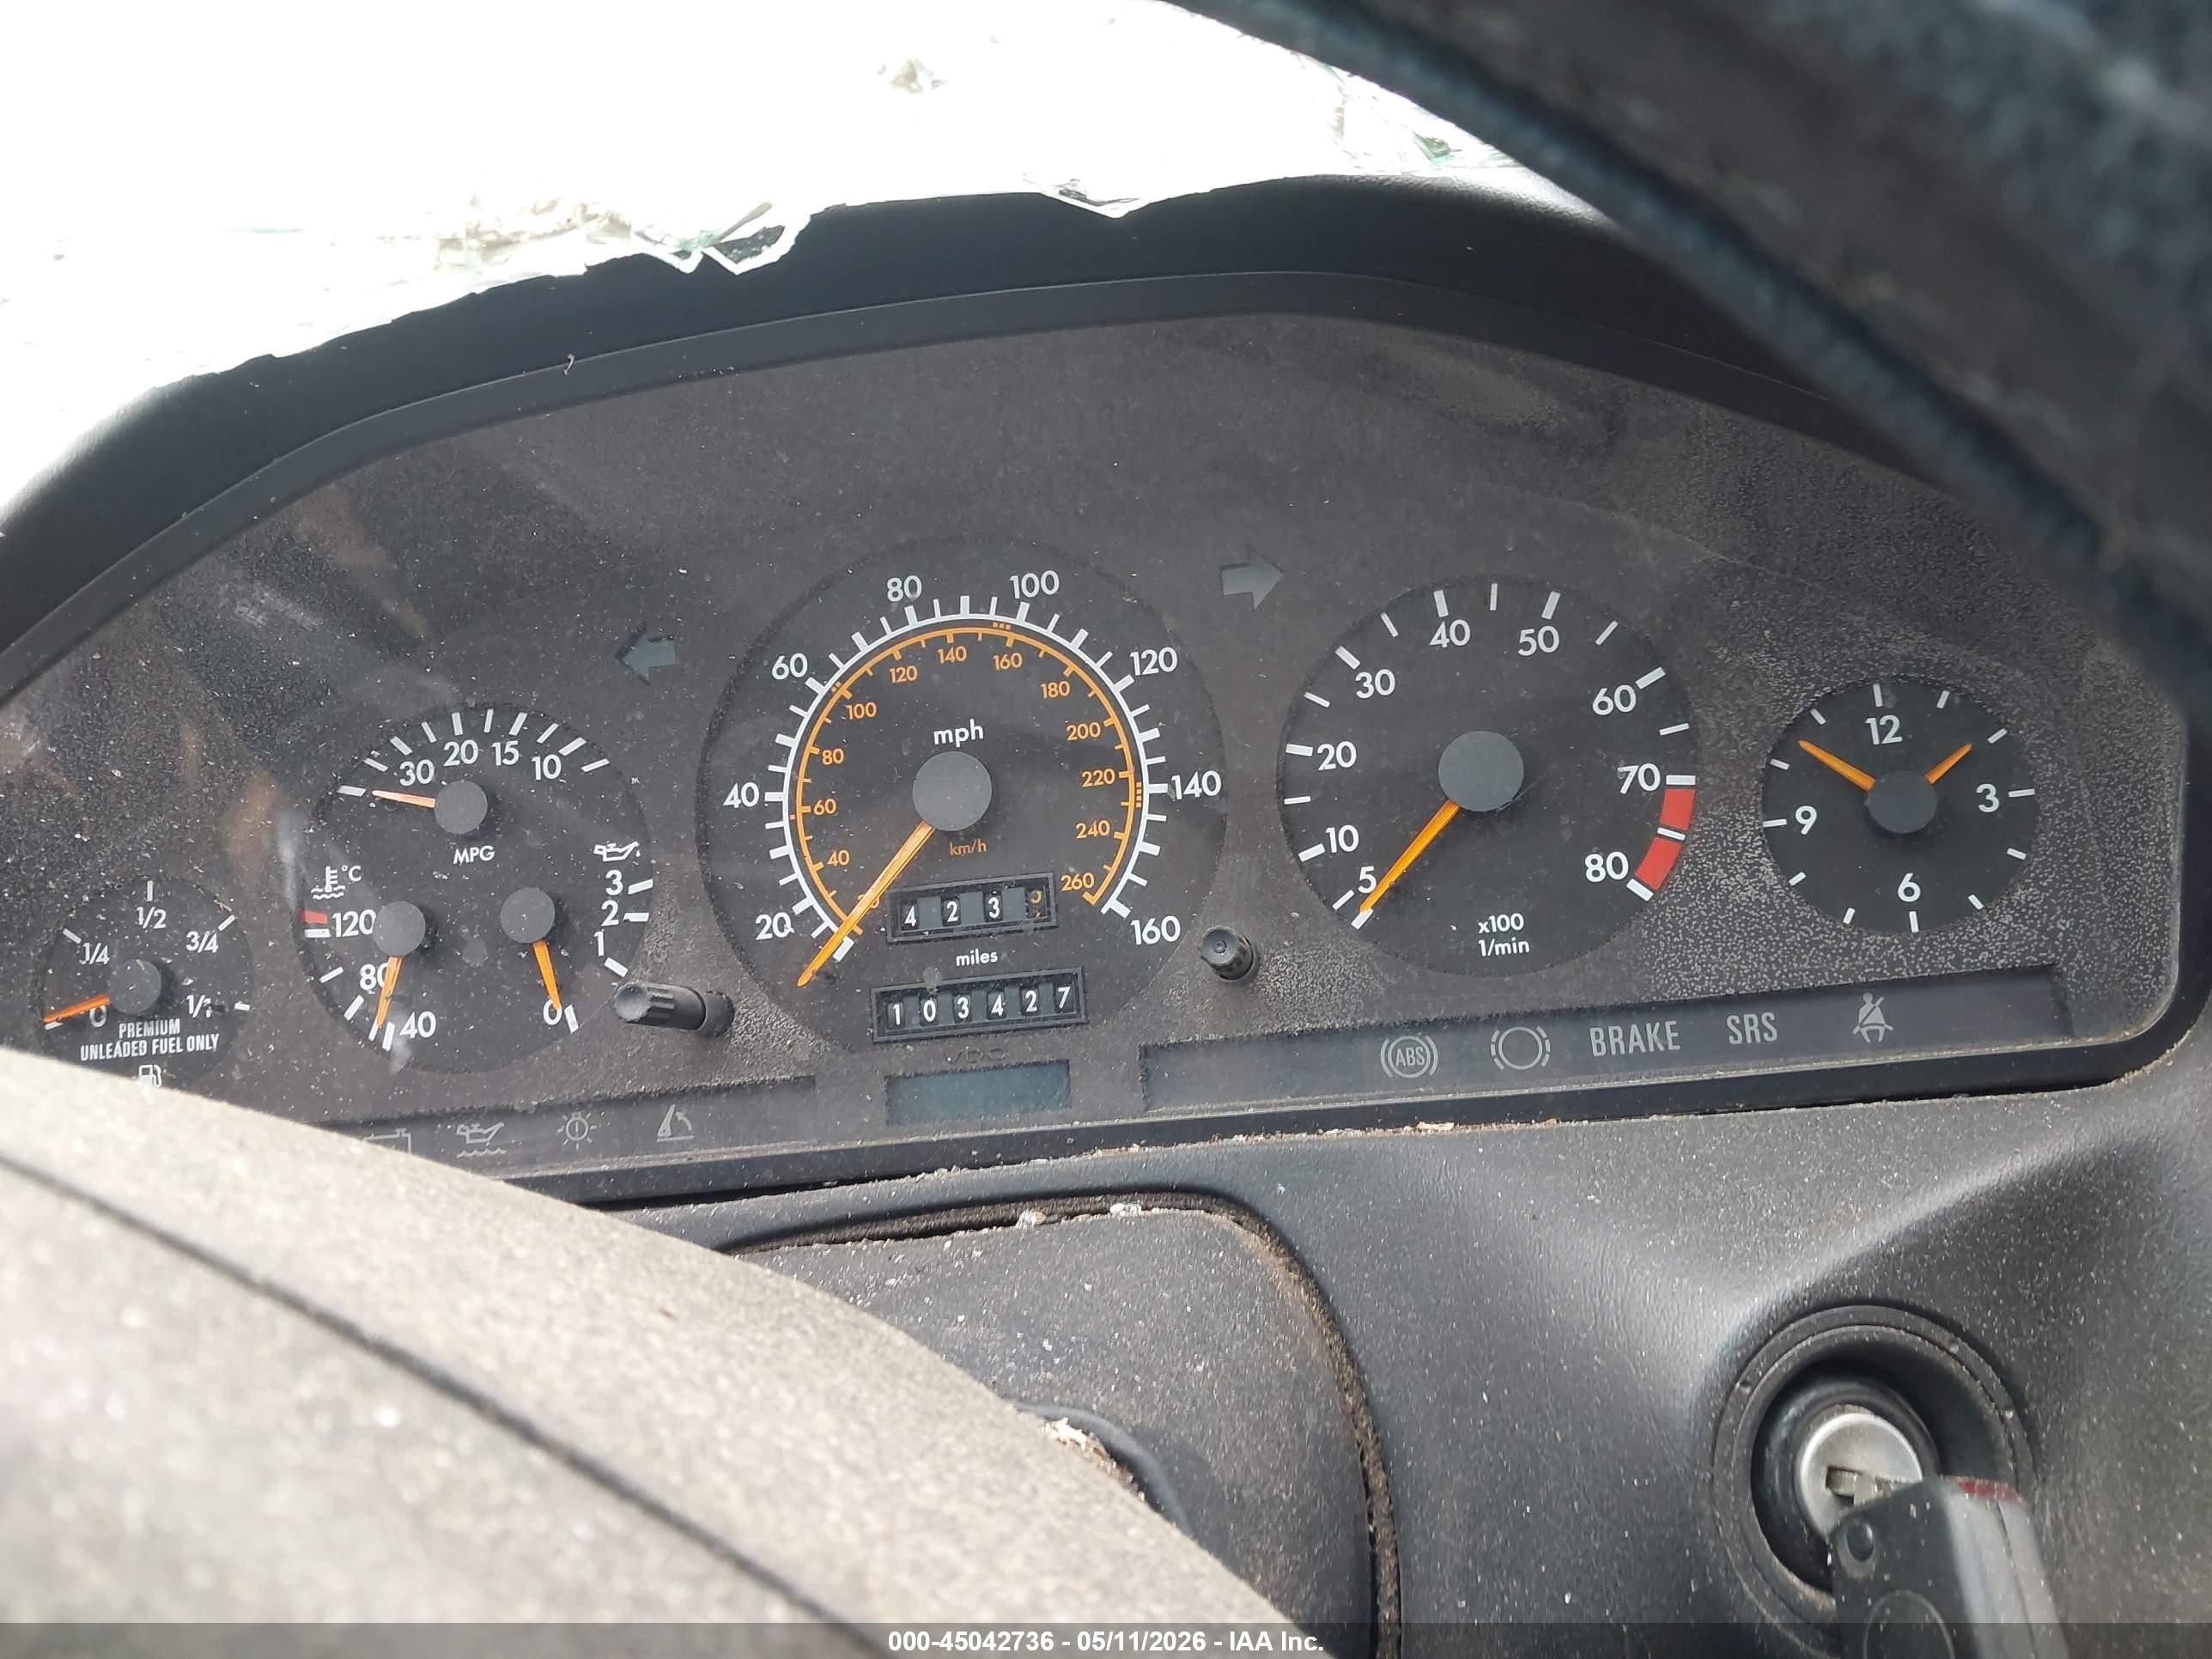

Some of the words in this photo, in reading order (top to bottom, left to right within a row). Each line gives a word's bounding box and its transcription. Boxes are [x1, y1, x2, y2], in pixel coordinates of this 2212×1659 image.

[886, 575, 922, 603] 80
[1010, 570, 1060, 599] 100
[1429, 619, 1471, 648] 40
[1517, 626, 1559, 656] 50
[772, 653, 808, 680] 60
[937, 646, 967, 664] 140
[993, 652, 1023, 671] 160
[1129, 647, 1178, 676] 120
[889, 665, 918, 683] 120
[1354, 669, 1395, 698] 30
[1040, 680, 1070, 699] 180
[1592, 684, 1637, 715] 60
[846, 702, 877, 719] 100
[933, 719, 984, 748] mph
[1066, 722, 1102, 741] 200
[1865, 714, 1903, 745] 12
[443, 739, 478, 767] 20
[492, 740, 520, 766] 15
[822, 747, 844, 765] 80
[1316, 741, 1357, 771] 20
[399, 759, 434, 787] 30
[532, 754, 562, 781] 10
[1081, 769, 1115, 787] 220
[1617, 763, 1661, 794] 70
[723, 781, 760, 809] 40
[1171, 770, 1221, 800] 140
[1976, 783, 2000, 812] 3
[813, 798, 836, 816] 60
[1795, 805, 1818, 835] 9
[1075, 820, 1110, 839] 240
[1324, 824, 1359, 854] 10
[453, 846, 495, 865] MPG
[827, 849, 850, 866] 40
[949, 838, 987, 856] km/h
[341, 866, 362, 882] °C
[1358, 866, 1377, 894] 5
[1584, 851, 1629, 883] 80
[605, 870, 623, 896] 3
[1060, 872, 1095, 891] 260
[1897, 872, 1921, 902] 6
[137, 906, 167, 929] 1/2
[331, 909, 376, 938] 120
[601, 901, 619, 927] 2
[755, 911, 791, 940] 20
[1477, 913, 1525, 934] x100
[186, 932, 219, 953] 3/4
[1130, 915, 1181, 945] 160
[79, 942, 110, 965] 1/4
[593, 931, 605, 957] 1
[1478, 939, 1530, 957] 1/min
[956, 950, 998, 967] miles
[88, 1004, 107, 1027] 0
[544, 999, 562, 1025] 0
[893, 986, 1071, 1026] 103427
[118, 1018, 180, 1038] PREMIUM
[399, 1012, 436, 1038] 40
[1726, 1012, 1778, 1045] SRS
[80, 1040, 148, 1061] UNLEADED
[151, 1037, 184, 1055] FUEL
[186, 1034, 220, 1052] ONLY
[1589, 1019, 1680, 1058] BRAKE
[1395, 1045, 1426, 1066] ABS
